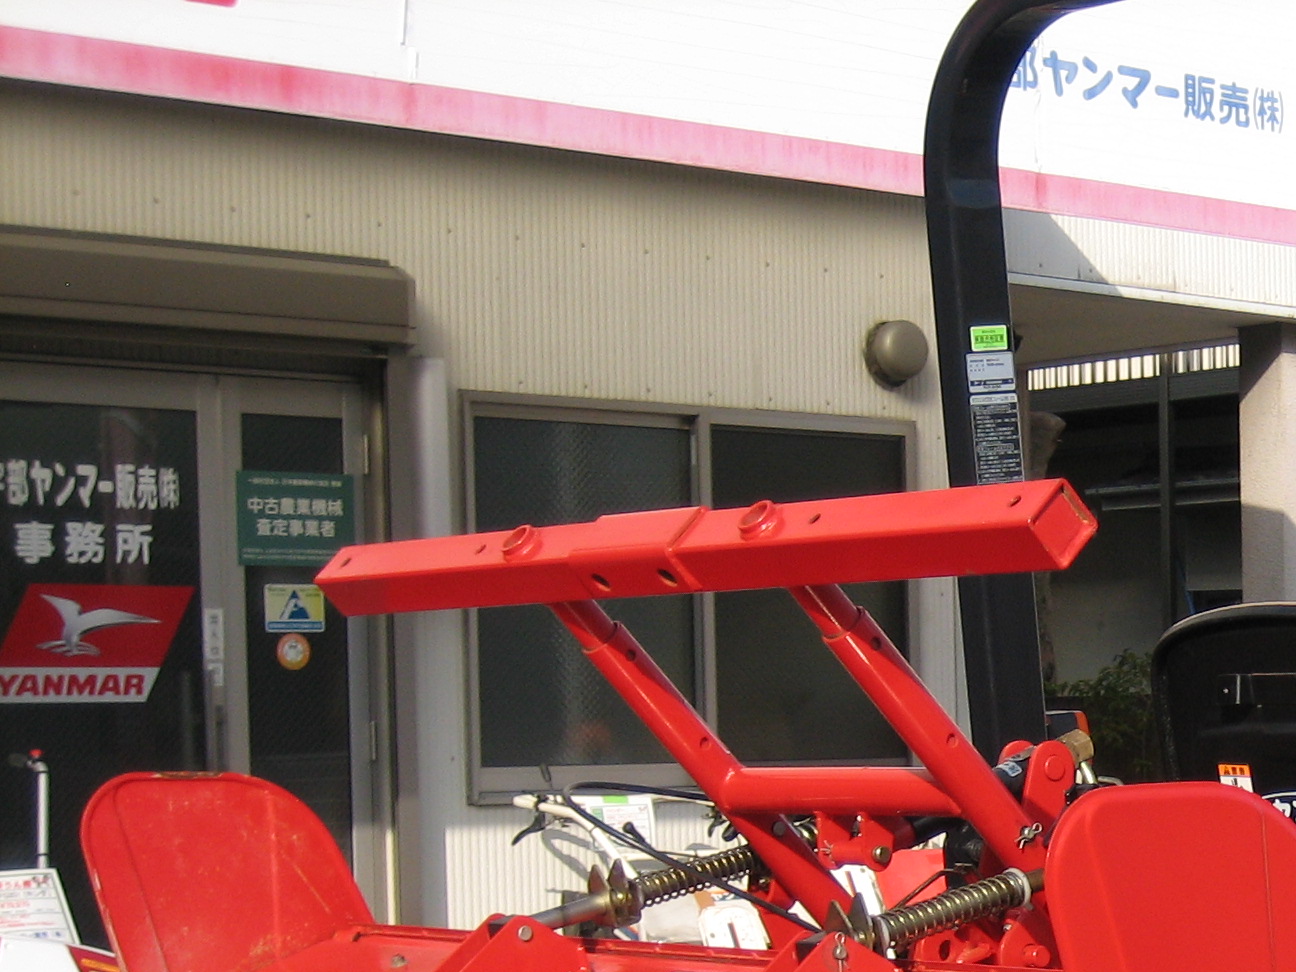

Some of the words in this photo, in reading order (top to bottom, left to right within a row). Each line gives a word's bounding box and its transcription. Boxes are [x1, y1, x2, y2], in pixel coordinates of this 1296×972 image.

[14, 521, 154, 565] 事務所
[0, 673, 146, 697] YANMAR
